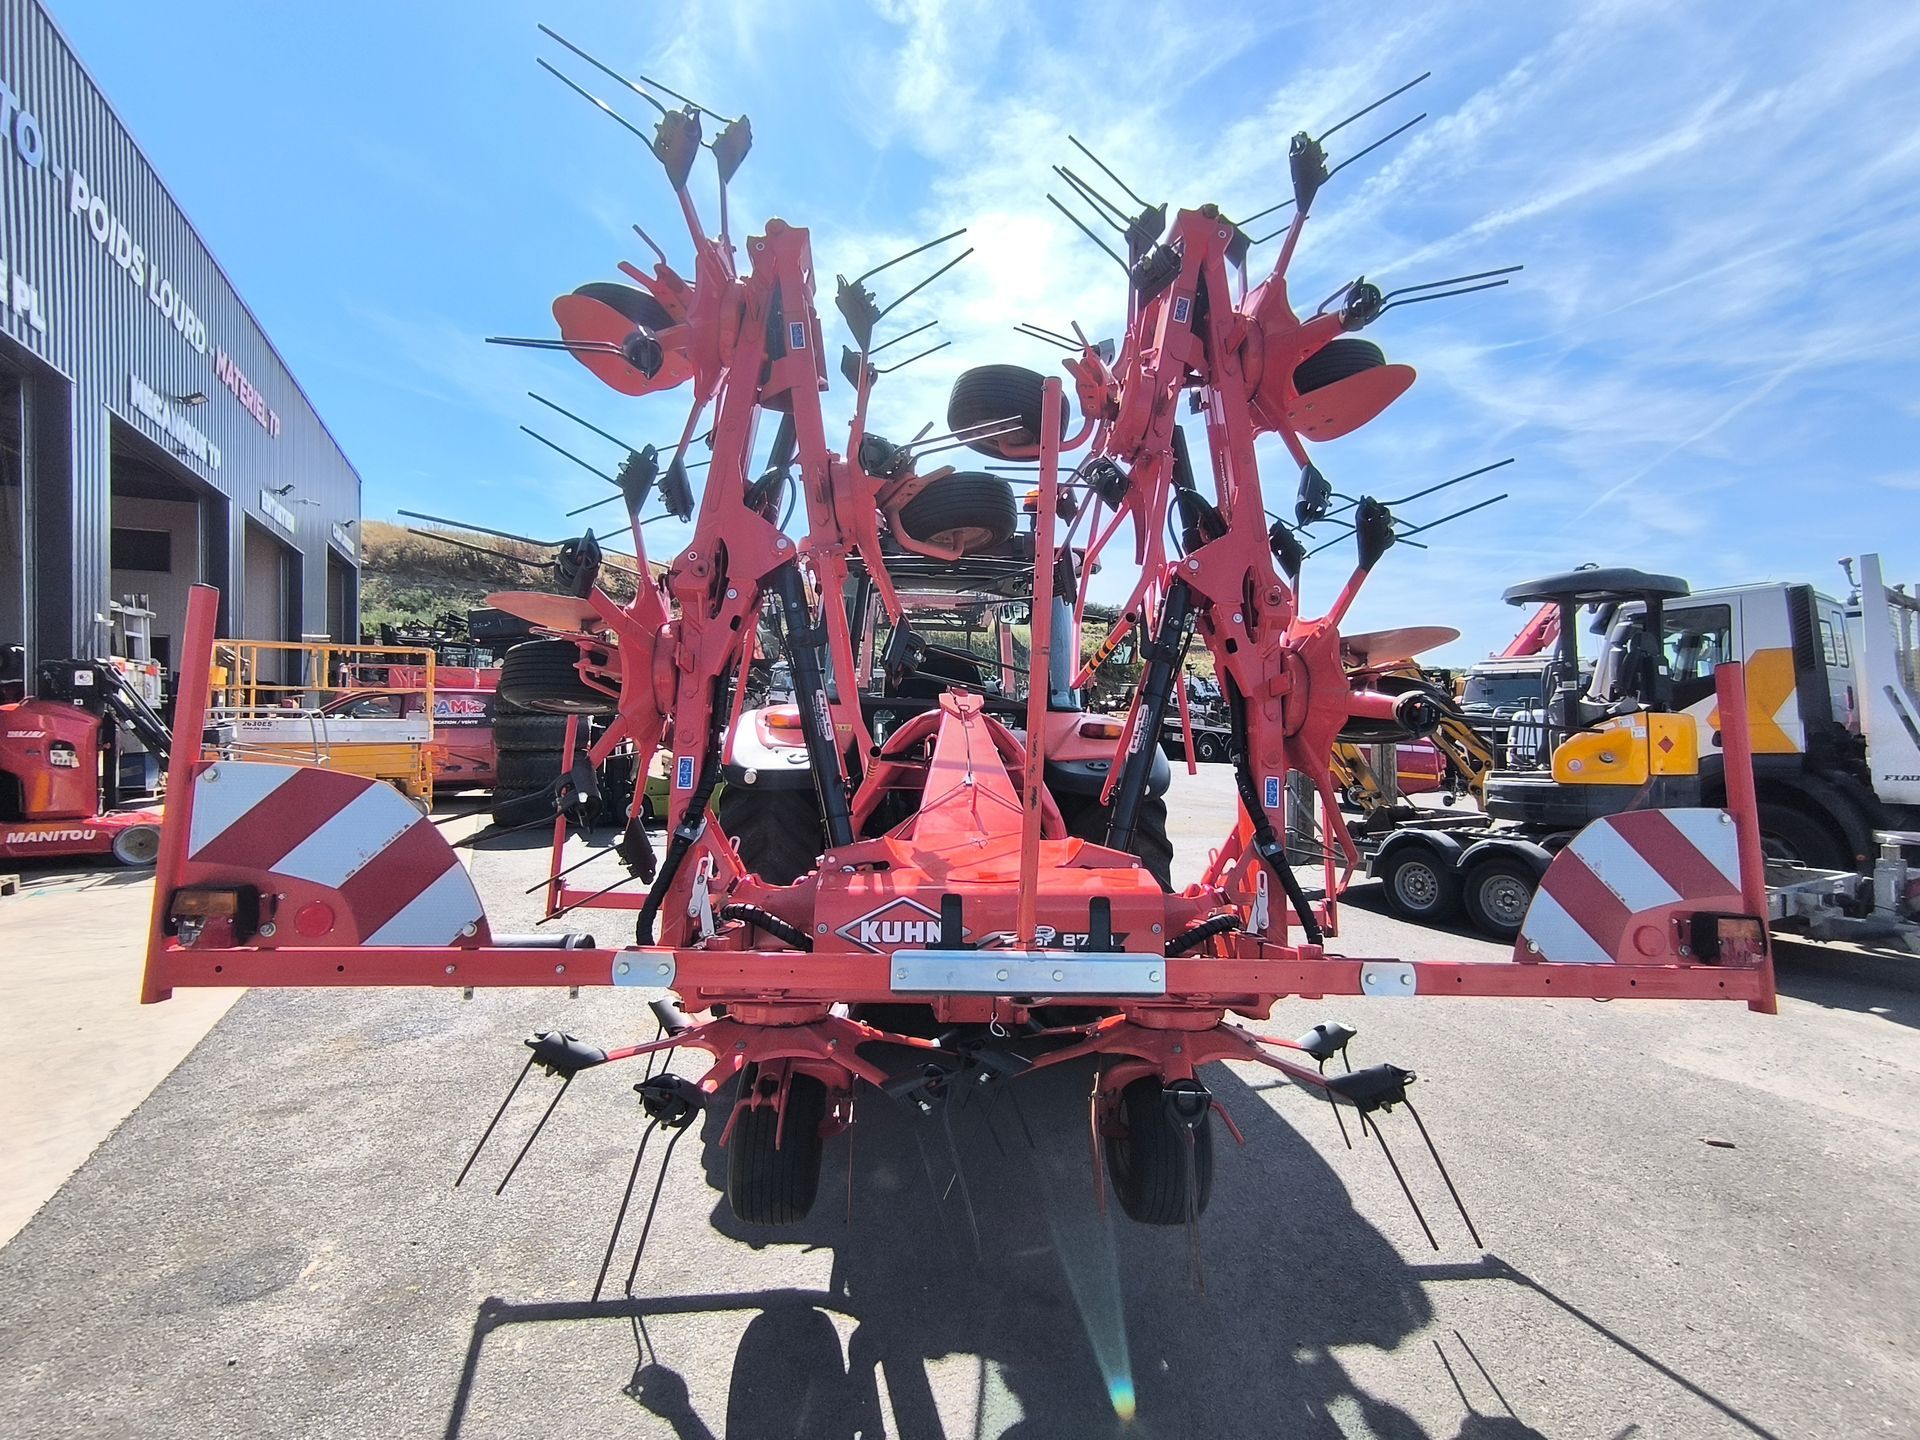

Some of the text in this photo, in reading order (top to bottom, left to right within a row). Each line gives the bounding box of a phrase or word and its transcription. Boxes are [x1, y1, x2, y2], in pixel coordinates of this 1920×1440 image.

[13, 272, 47, 334] PL
[71, 168, 145, 287] POIDS
[149, 264, 207, 354] LOURD
[215, 345, 267, 429] MATERIEL
[268, 408, 280, 439] TP
[6, 829, 97, 844] MANITOU
[860, 920, 942, 944] KUHN
